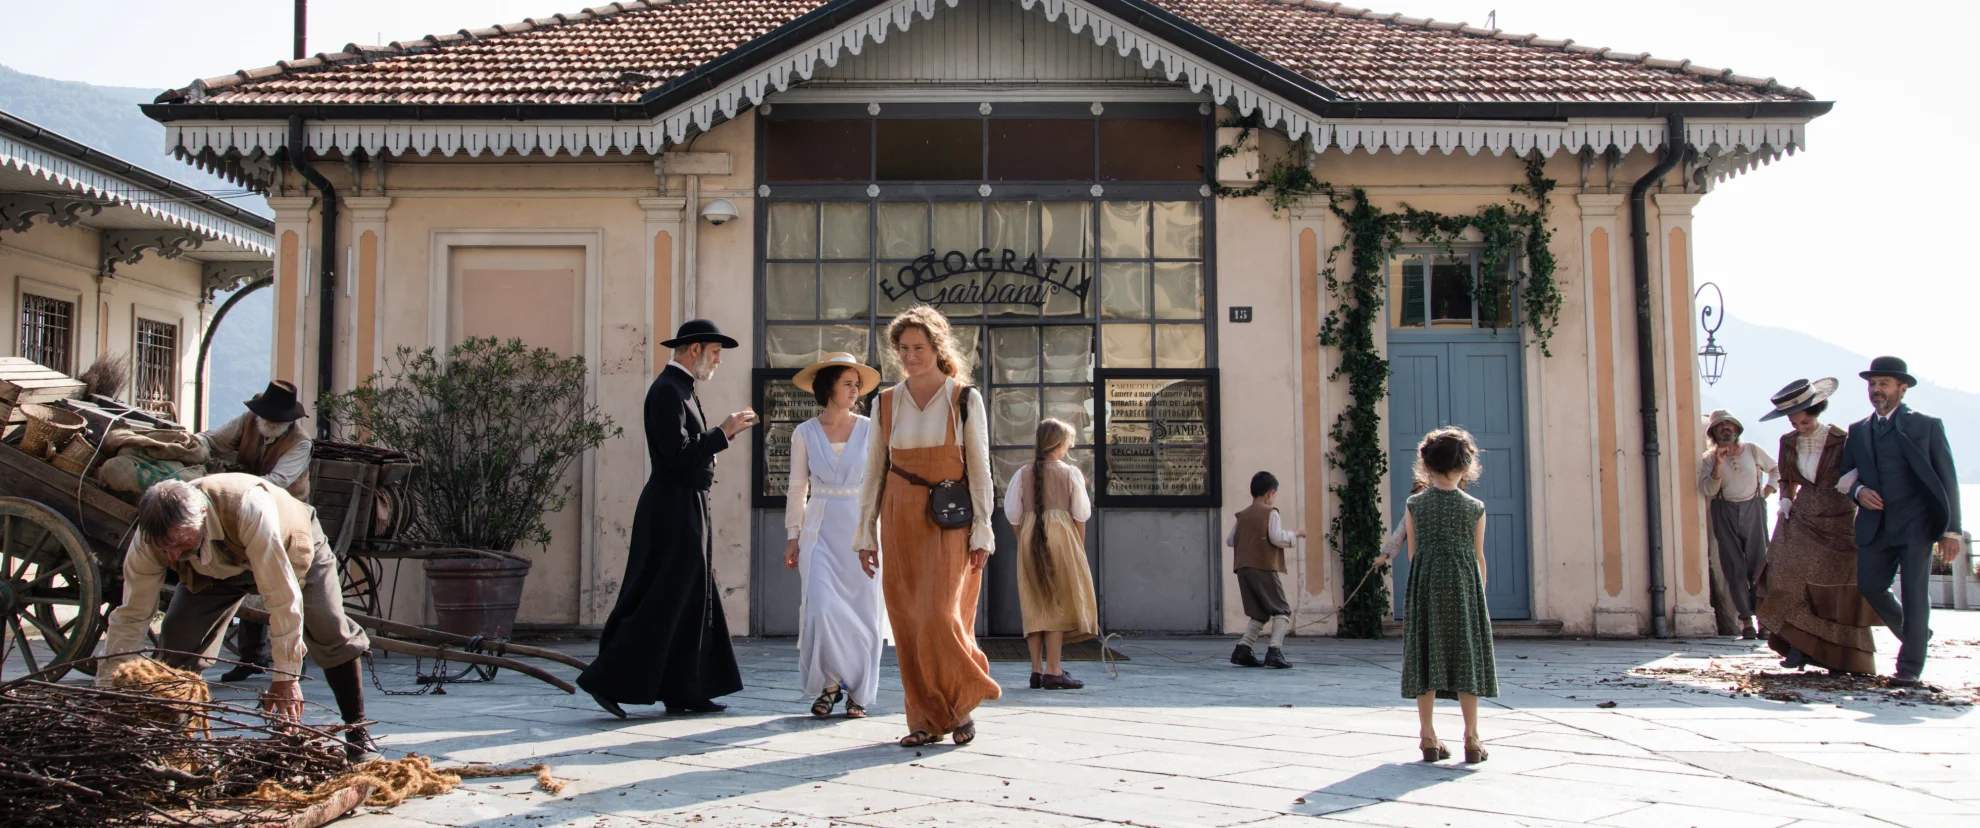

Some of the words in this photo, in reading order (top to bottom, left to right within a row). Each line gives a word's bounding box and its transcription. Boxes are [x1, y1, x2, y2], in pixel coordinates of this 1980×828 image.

[879, 248, 1092, 302] FOTOGRAFIA
[1235, 309, 1248, 320] 15
[1111, 389, 1133, 398] Camere
[1160, 389, 1183, 398] Camere
[1111, 409, 1154, 418] APPARECCHI
[1154, 419, 1205, 439] STAMPA
